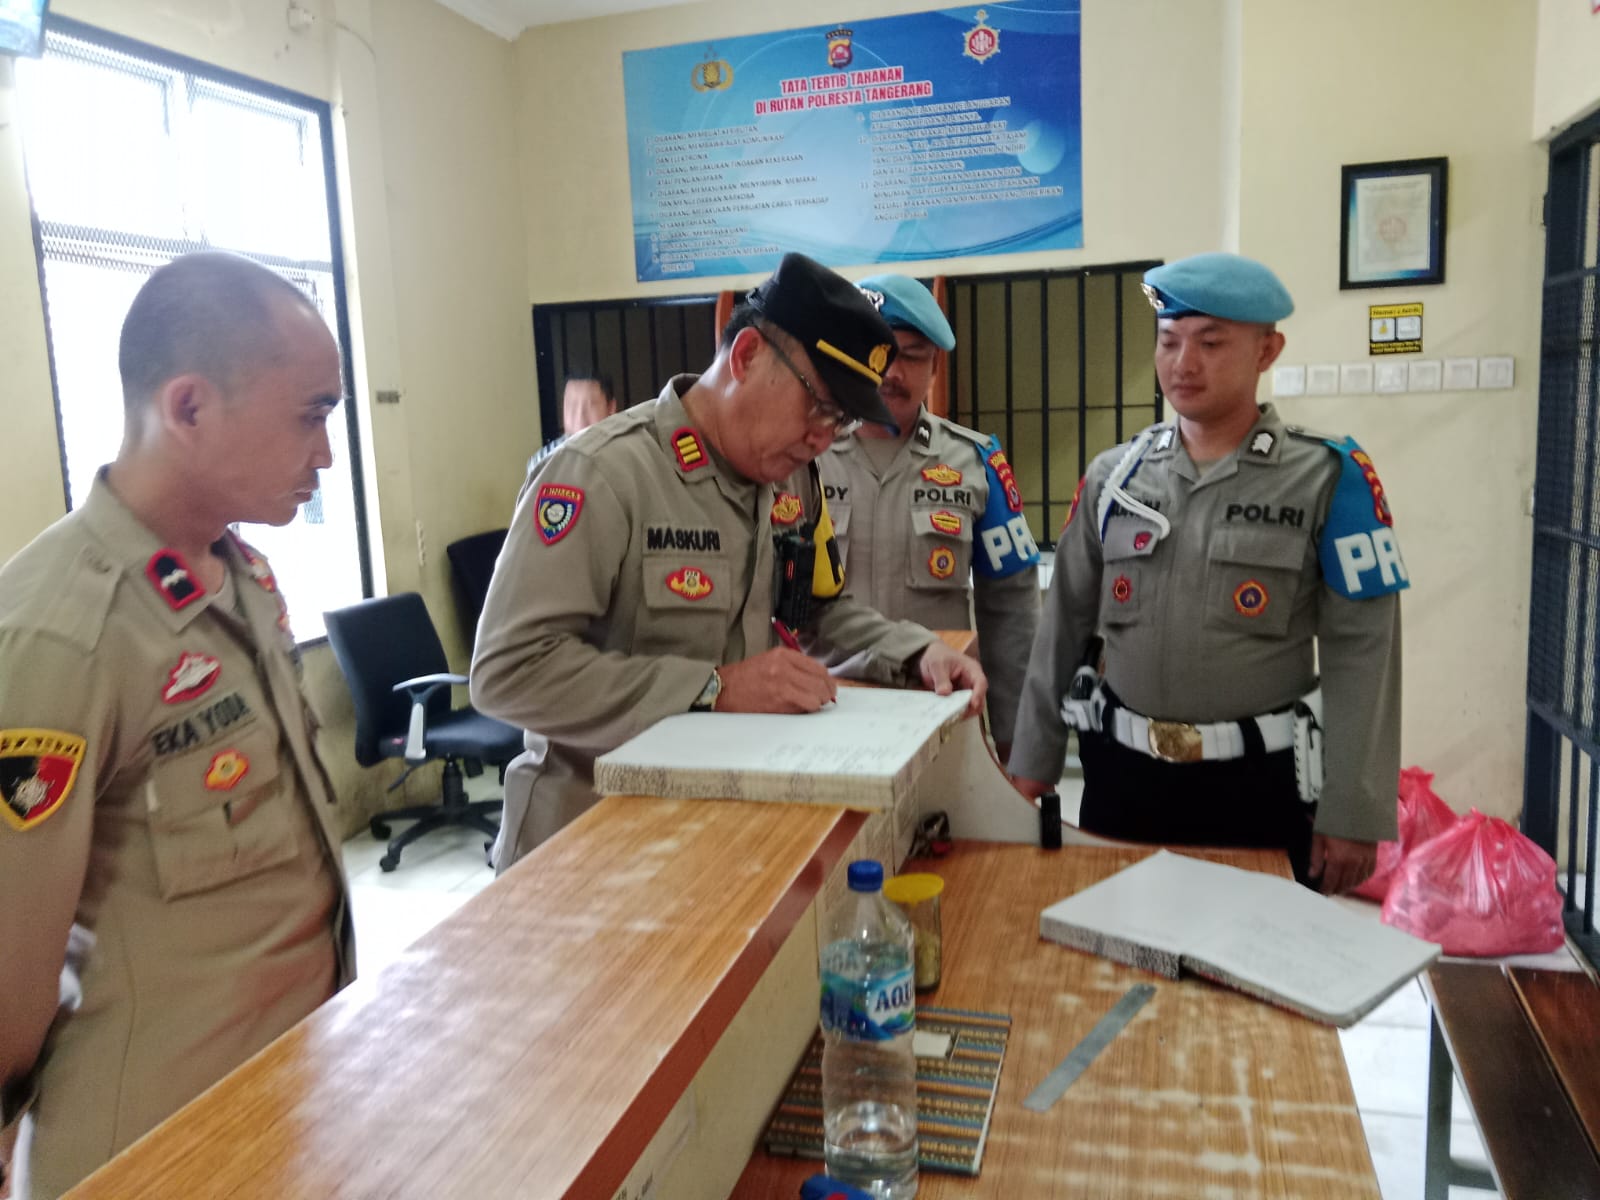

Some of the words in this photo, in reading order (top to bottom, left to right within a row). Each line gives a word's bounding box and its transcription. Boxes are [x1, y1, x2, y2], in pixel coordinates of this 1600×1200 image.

[781, 77, 807, 93] TATA
[810, 73, 846, 89] TERTIB
[850, 67, 901, 85] TAHANAN
[755, 100, 766, 113] DI
[770, 96, 803, 112] RUTAN
[807, 90, 861, 108] POLRESTA
[864, 82, 930, 102] TANGERANG
[914, 488, 972, 506] POLRI
[1226, 504, 1306, 527] POLRI
